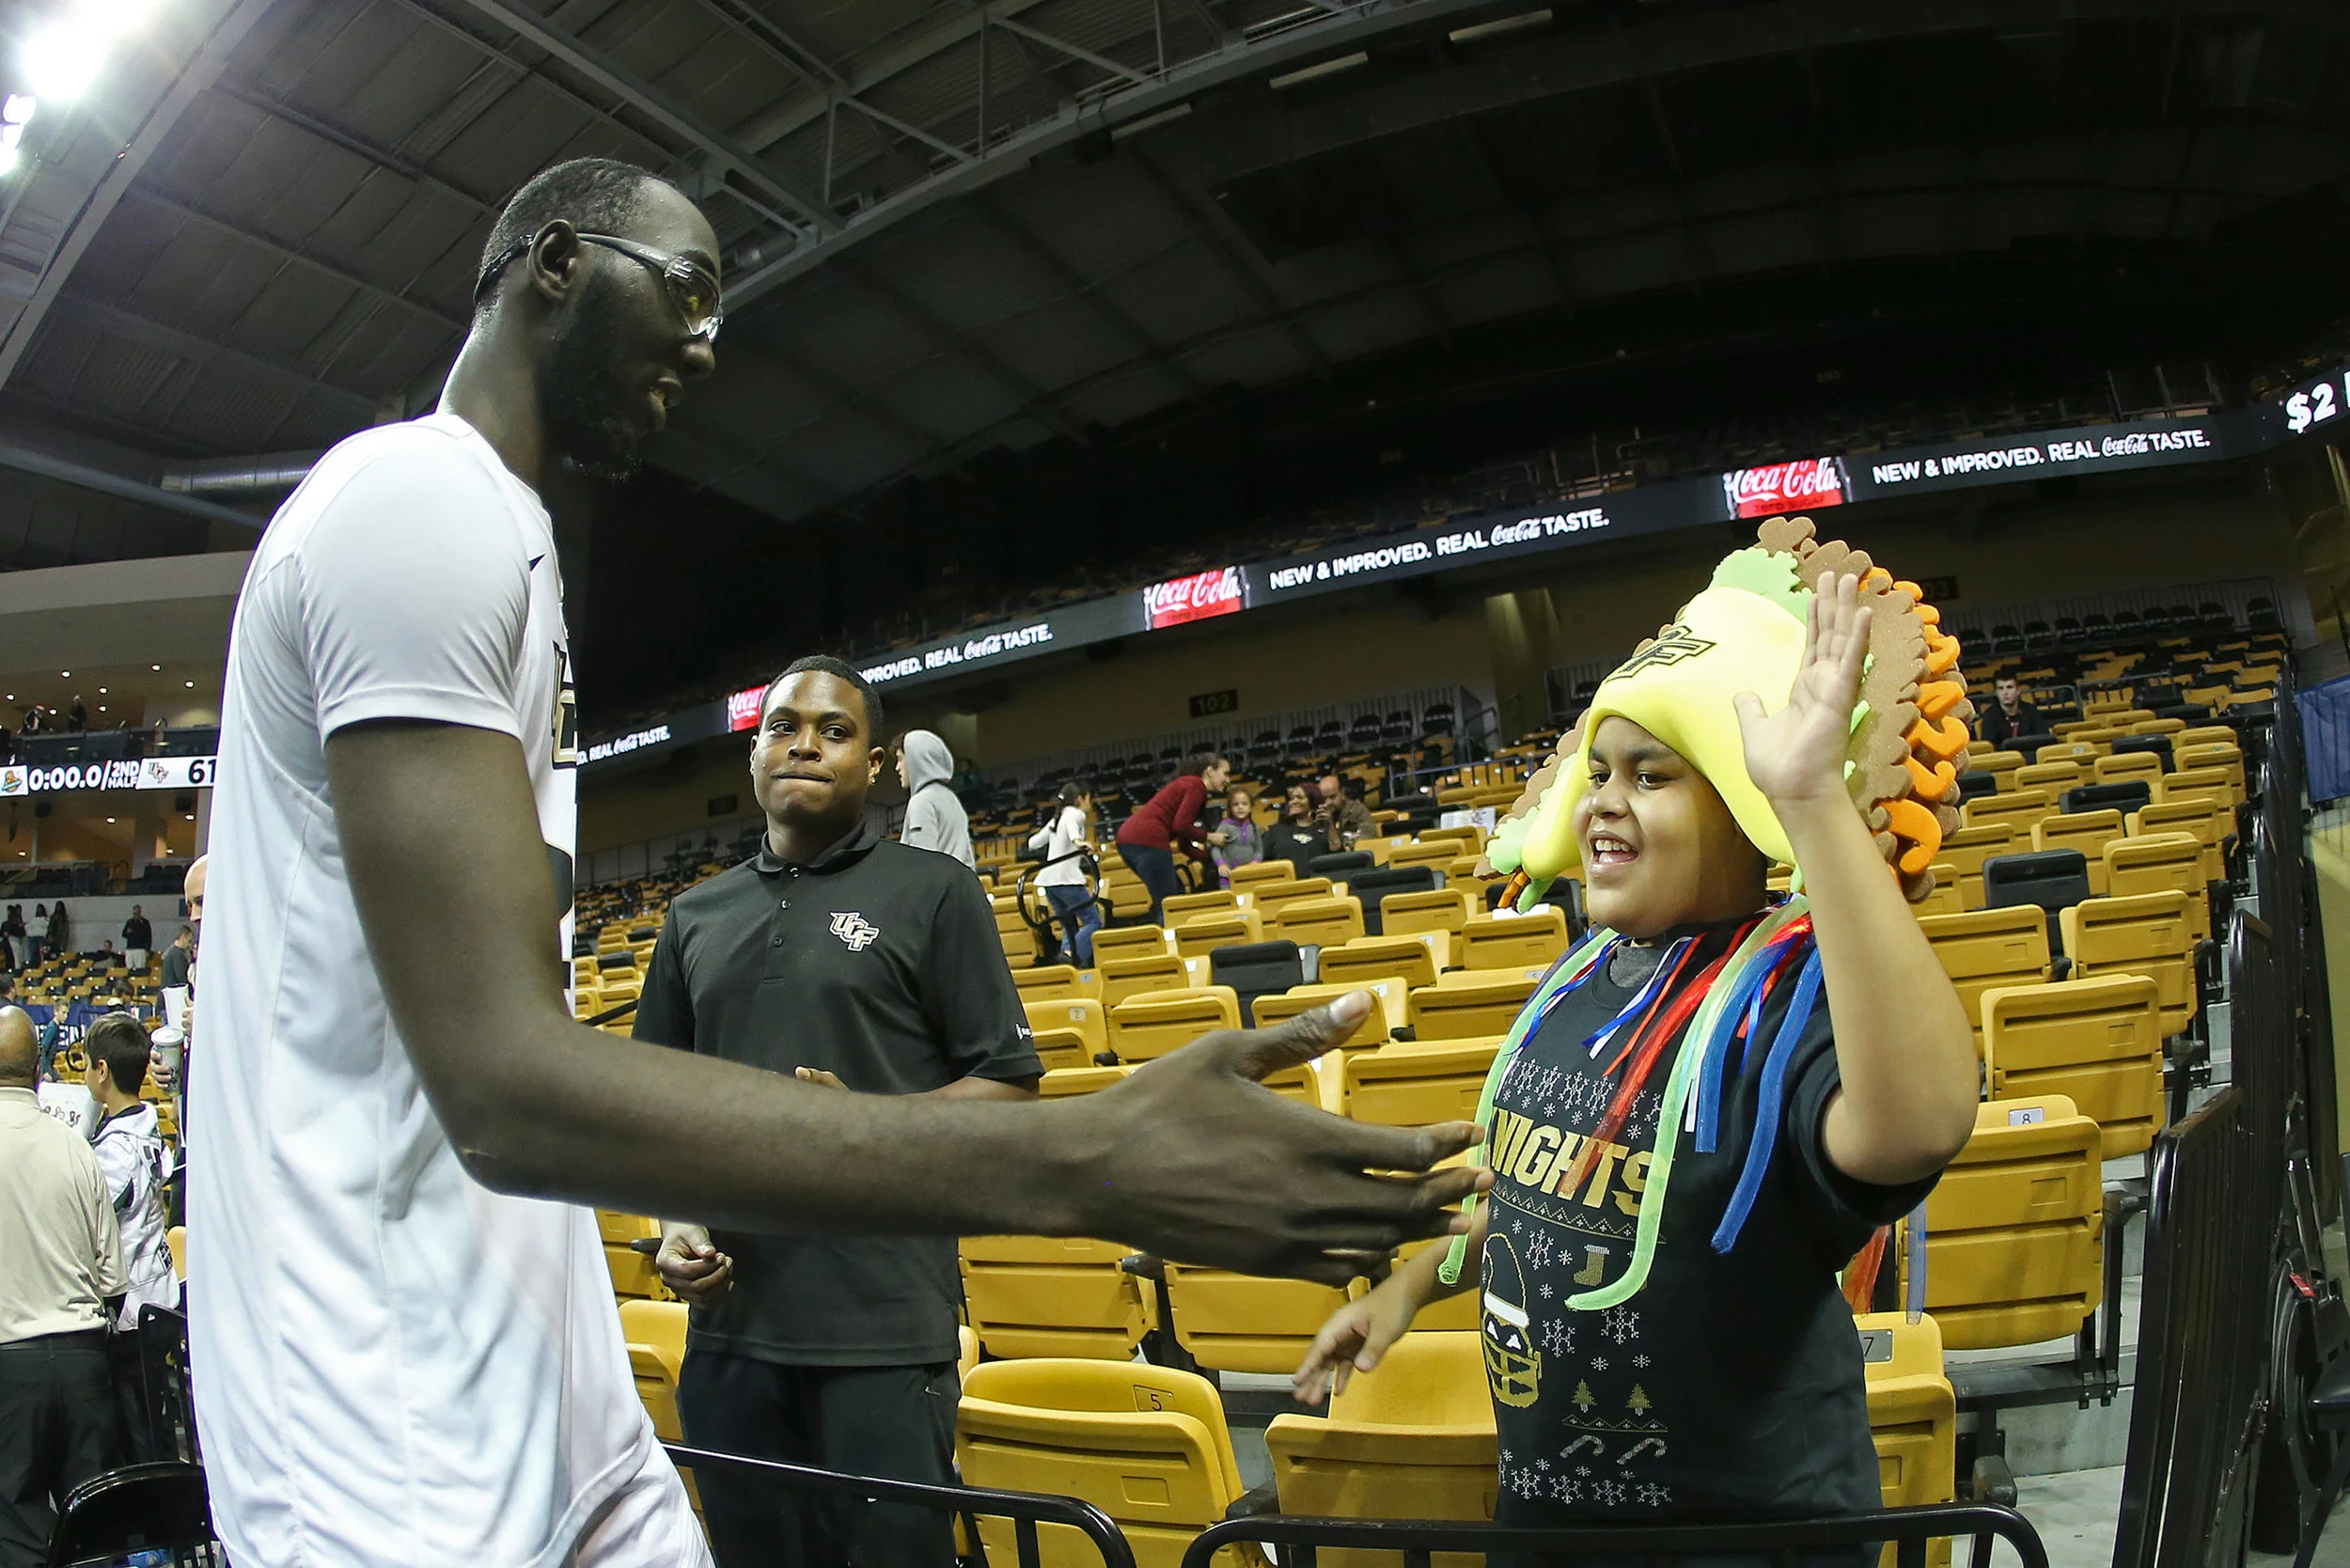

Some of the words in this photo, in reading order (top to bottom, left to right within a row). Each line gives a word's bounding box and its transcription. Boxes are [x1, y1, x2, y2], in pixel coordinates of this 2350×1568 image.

[2286, 391, 2337, 434] $2
[1872, 462, 1920, 484] NEW
[1924, 459, 1940, 478] &
[1942, 446, 2044, 474] IMPROVED.
[2048, 439, 2100, 463] REAL
[2149, 429, 2211, 452] TASTE.
[1723, 457, 1842, 504] Coca-Cola
[1269, 564, 1313, 590] NEW
[1316, 561, 1331, 580] &
[1333, 541, 1433, 577] IMPROVED.
[1435, 529, 1489, 556] REAL
[1542, 508, 1610, 536] TASTE.
[1144, 565, 1243, 614] Coca-Cola
[925, 646, 964, 669] REAL
[1002, 623, 1054, 650] TASTE.
[588, 743, 613, 761] REAL
[637, 725, 671, 747] TASTE.
[107, 776, 137, 789] HALF
[111, 760, 140, 777] 2ND
[829, 911, 881, 952] UCF
[1492, 1105, 1666, 1217] NIGHTS
[1863, 1337, 1875, 1356] 7
[1150, 1393, 1163, 1411] 5
